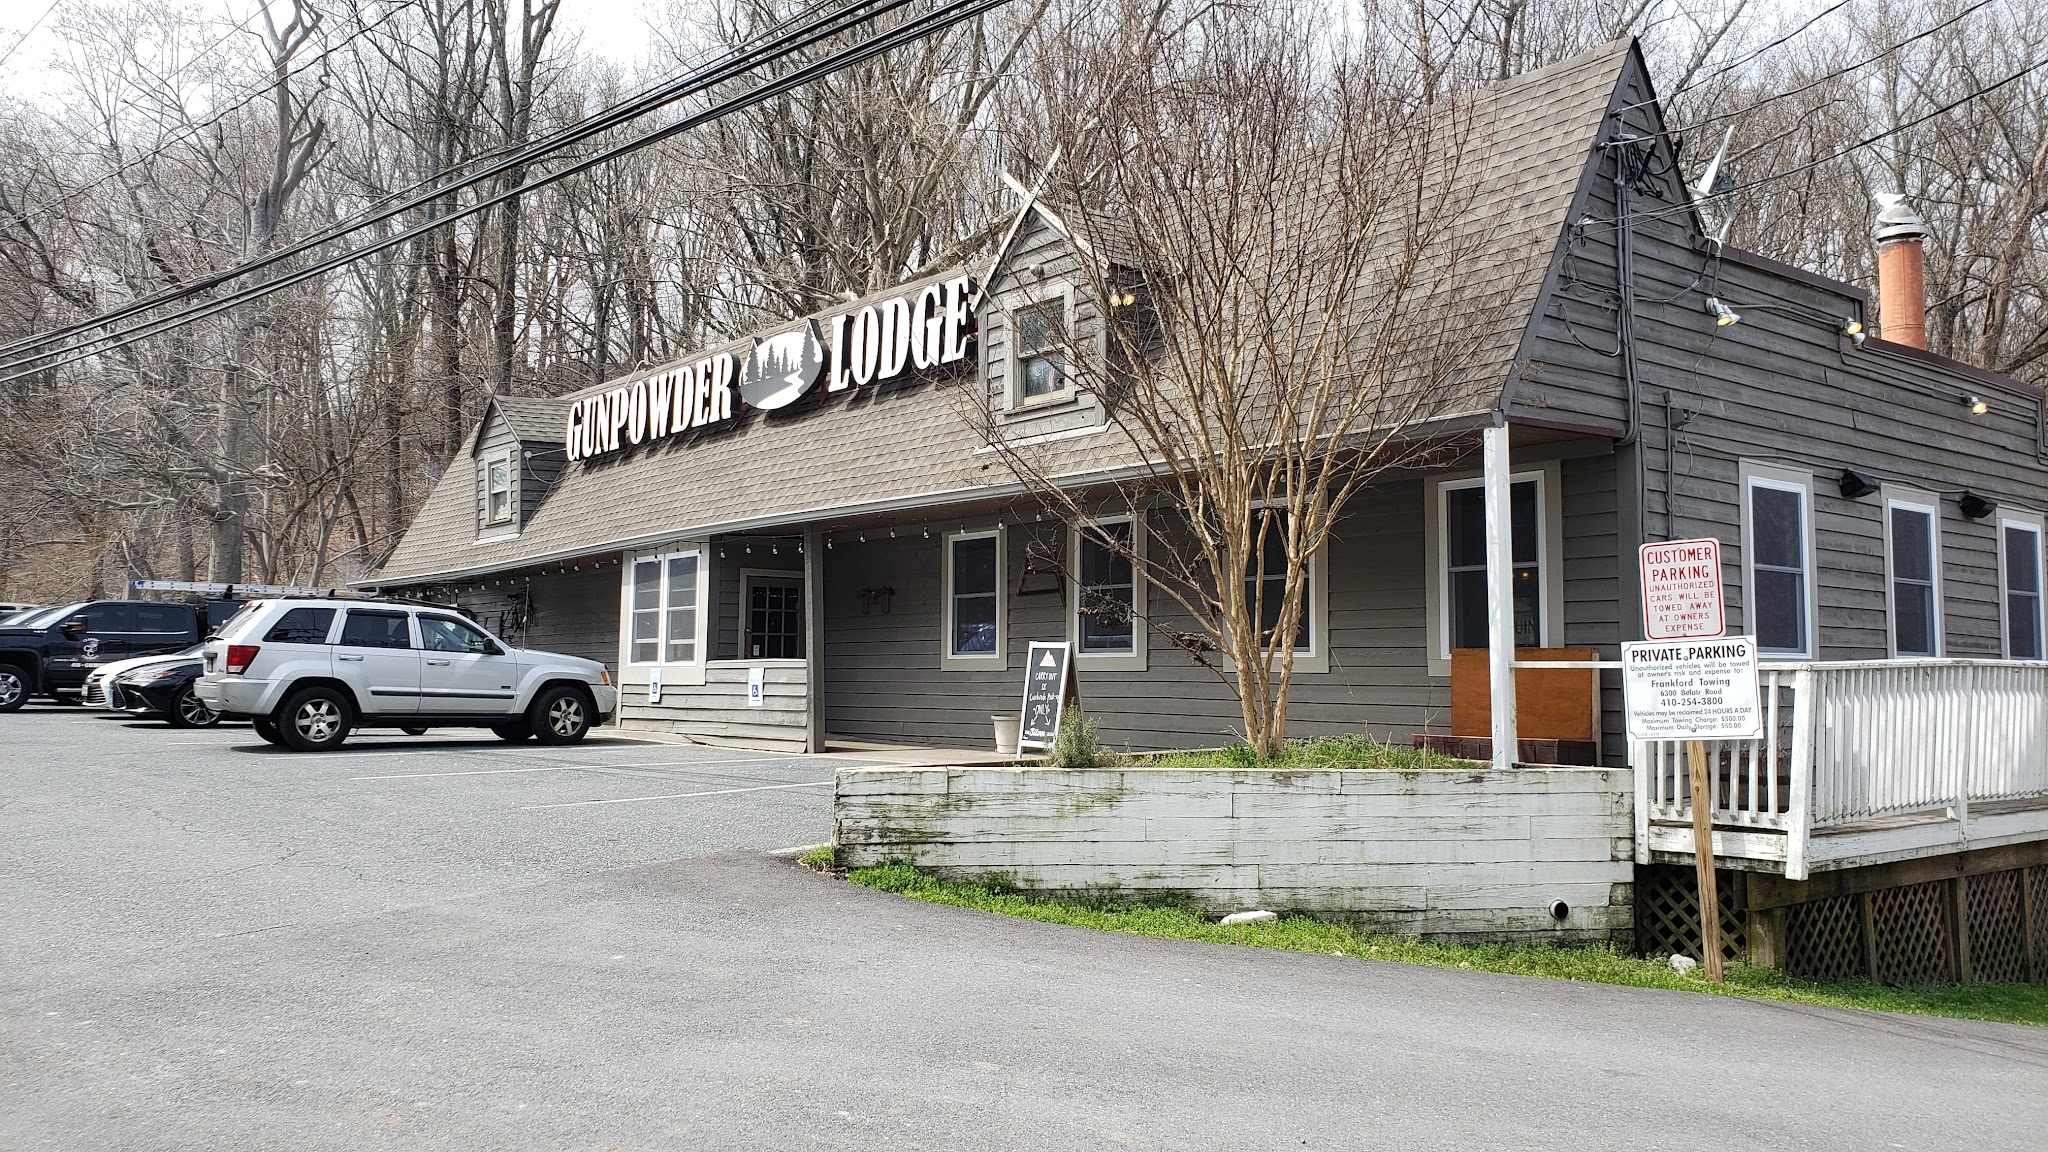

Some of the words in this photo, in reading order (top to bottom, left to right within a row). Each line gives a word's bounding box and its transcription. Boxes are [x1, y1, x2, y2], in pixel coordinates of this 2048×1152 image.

[566, 352, 734, 461] GUNPOWDER
[828, 275, 971, 393] LODGE
[1648, 548, 1711, 564] CUSTOMER
[1653, 565, 1708, 582] PARKING
[1650, 581, 1714, 592] UNAUTHORIZED
[1650, 594, 1672, 602] CARS
[1654, 604, 1682, 612] TOWED
[1690, 602, 1712, 610] AWAY
[1674, 613, 1709, 621] OWNERS
[1666, 623, 1704, 632] EXPENSE
[1632, 648, 1682, 662] PRIVATE
[1689, 645, 1745, 660] PARKING
[1652, 679, 1693, 687] Frankford
[1699, 678, 1730, 686] Towing
[1661, 698, 1723, 706] 410-254-3800
